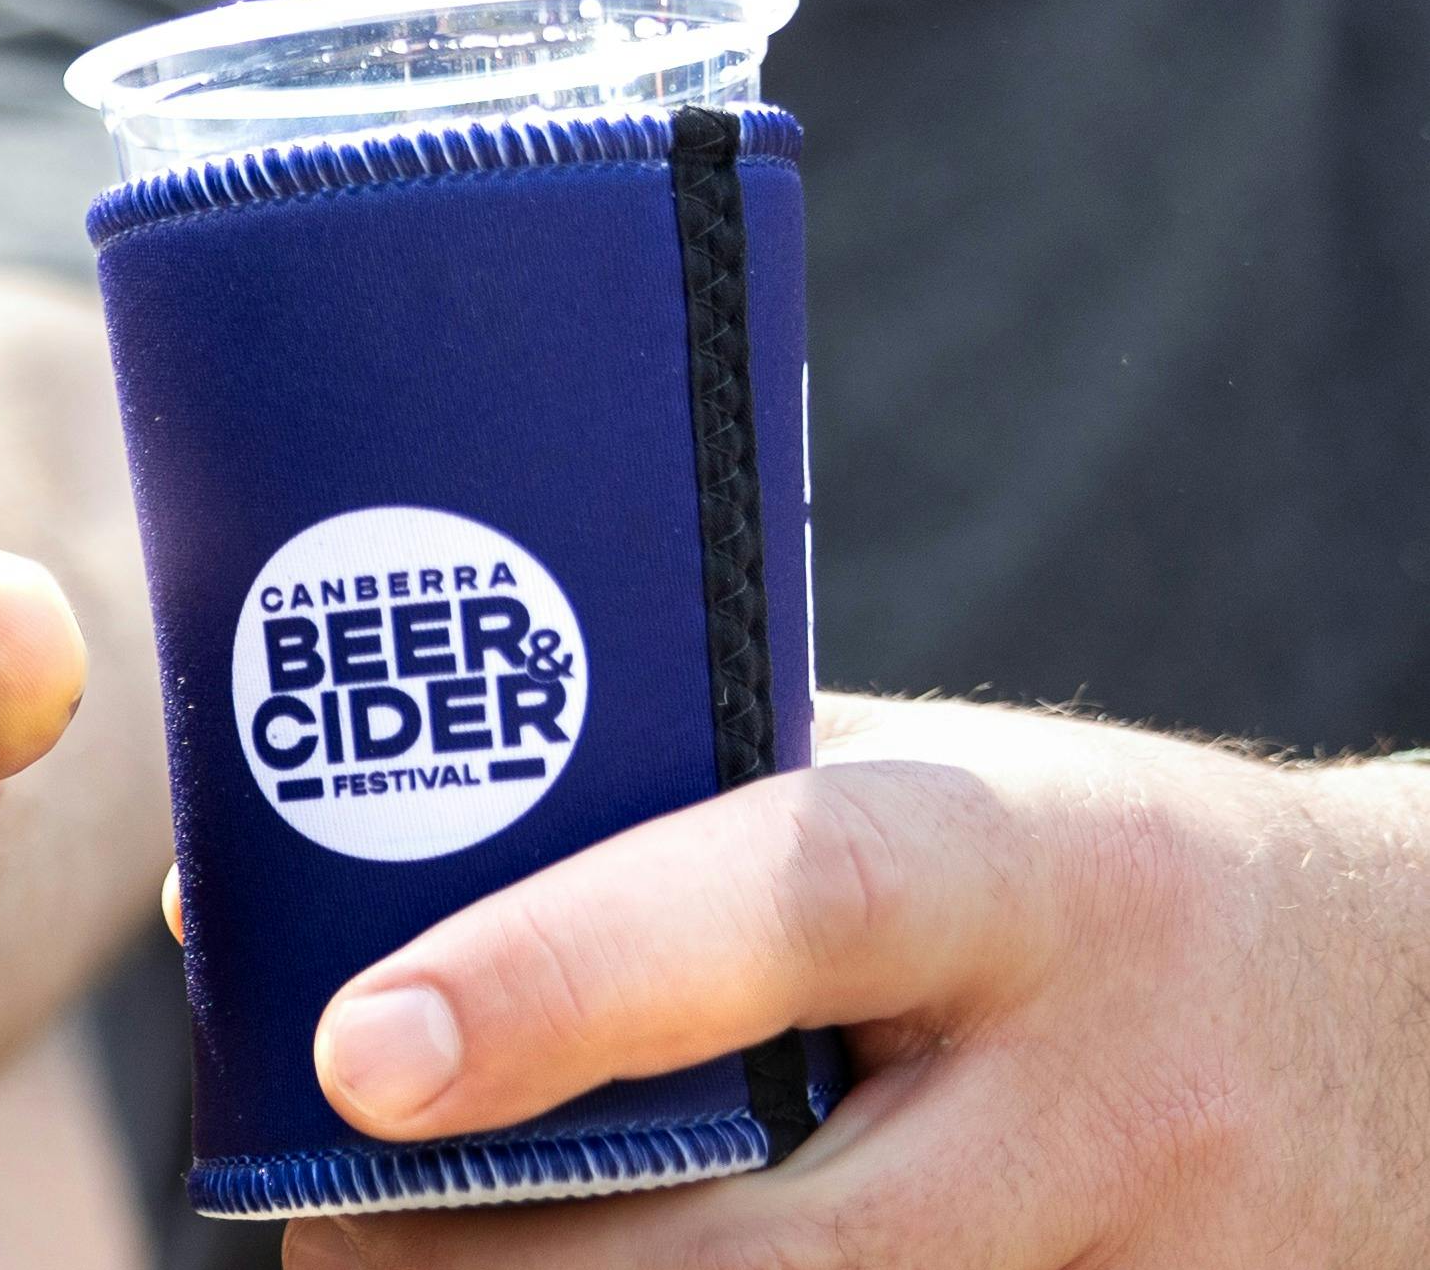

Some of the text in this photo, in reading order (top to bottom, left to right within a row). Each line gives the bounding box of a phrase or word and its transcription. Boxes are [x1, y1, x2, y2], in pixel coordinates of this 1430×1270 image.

[260, 562, 517, 613] CANBERRA
[263, 595, 530, 693] BEER
[252, 672, 570, 771] CIDER
[332, 763, 480, 798] FESTIVAL
